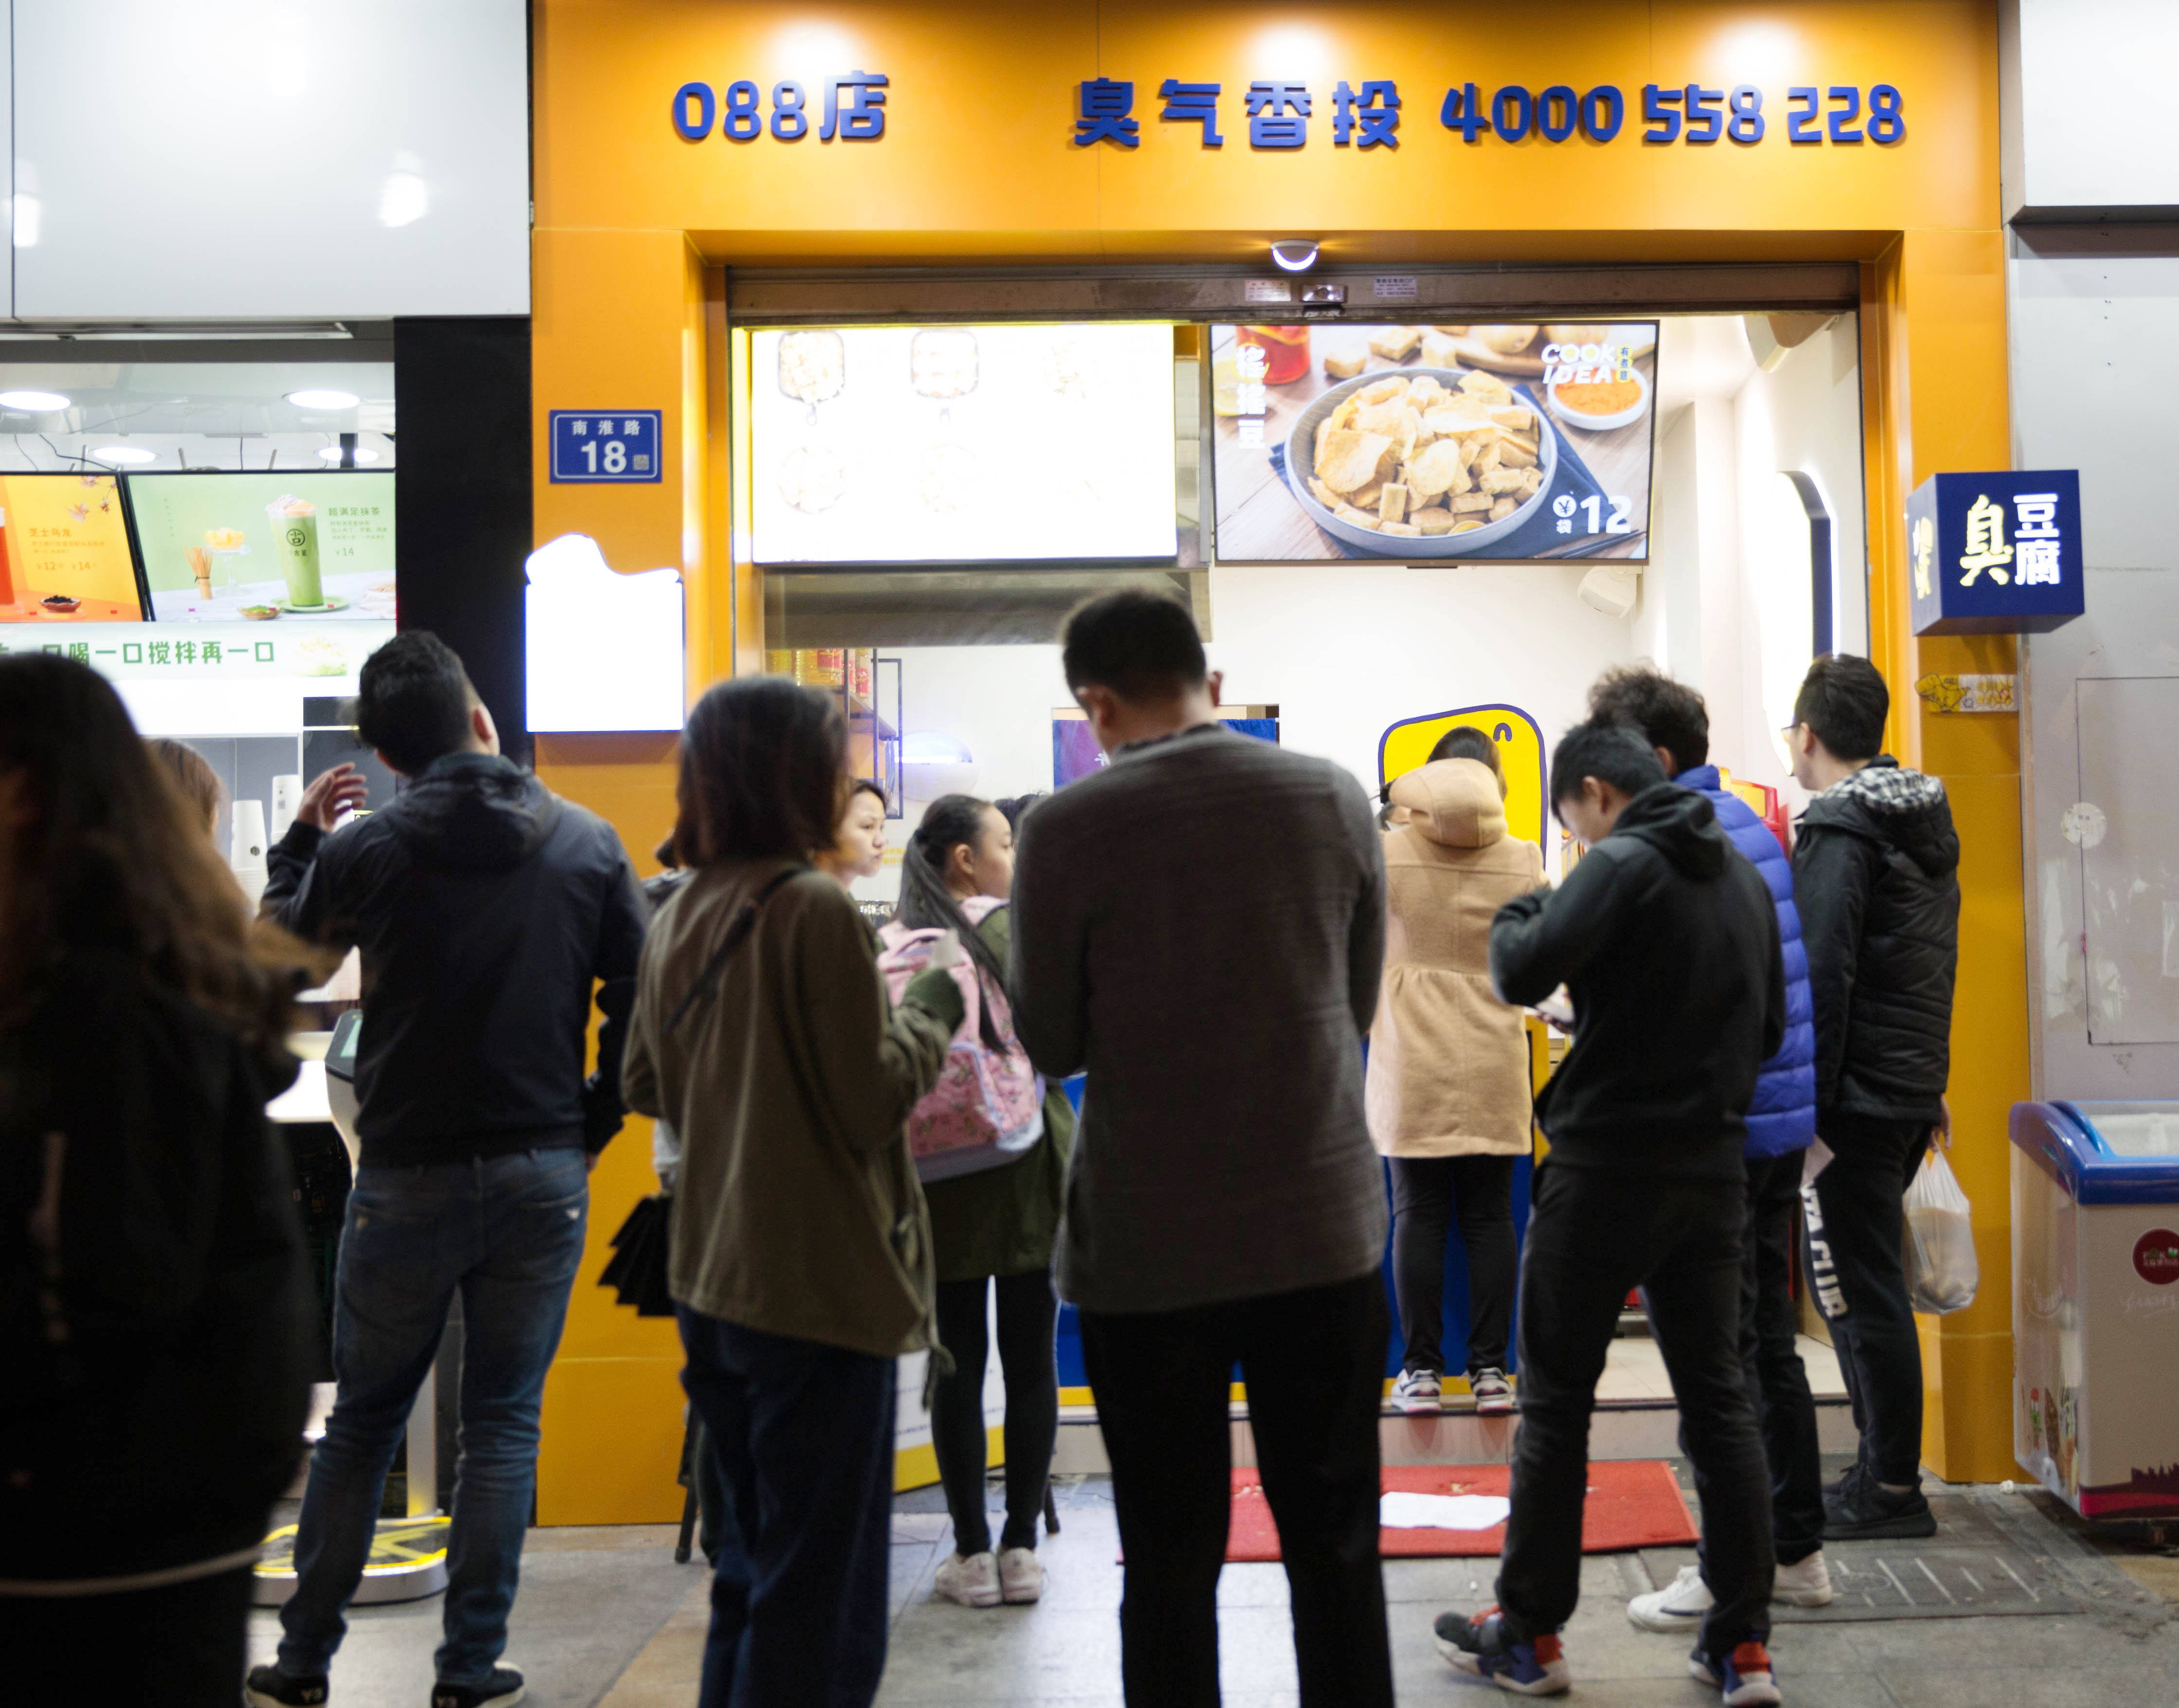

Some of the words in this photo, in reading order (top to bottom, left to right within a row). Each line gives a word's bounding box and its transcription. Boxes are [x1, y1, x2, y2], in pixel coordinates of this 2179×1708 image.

[674, 70, 889, 140] 088店
[1075, 77, 1399, 148] 臭气香投
[1440, 83, 1625, 142] 4000
[1646, 83, 1765, 142] 558
[1788, 84, 1904, 142] 228
[1541, 343, 1616, 364] COOK
[1543, 365, 1613, 384] IDEA
[581, 440, 627, 473] 18
[1580, 495, 1632, 534] 12
[2013, 493, 2061, 585] 豆腐
